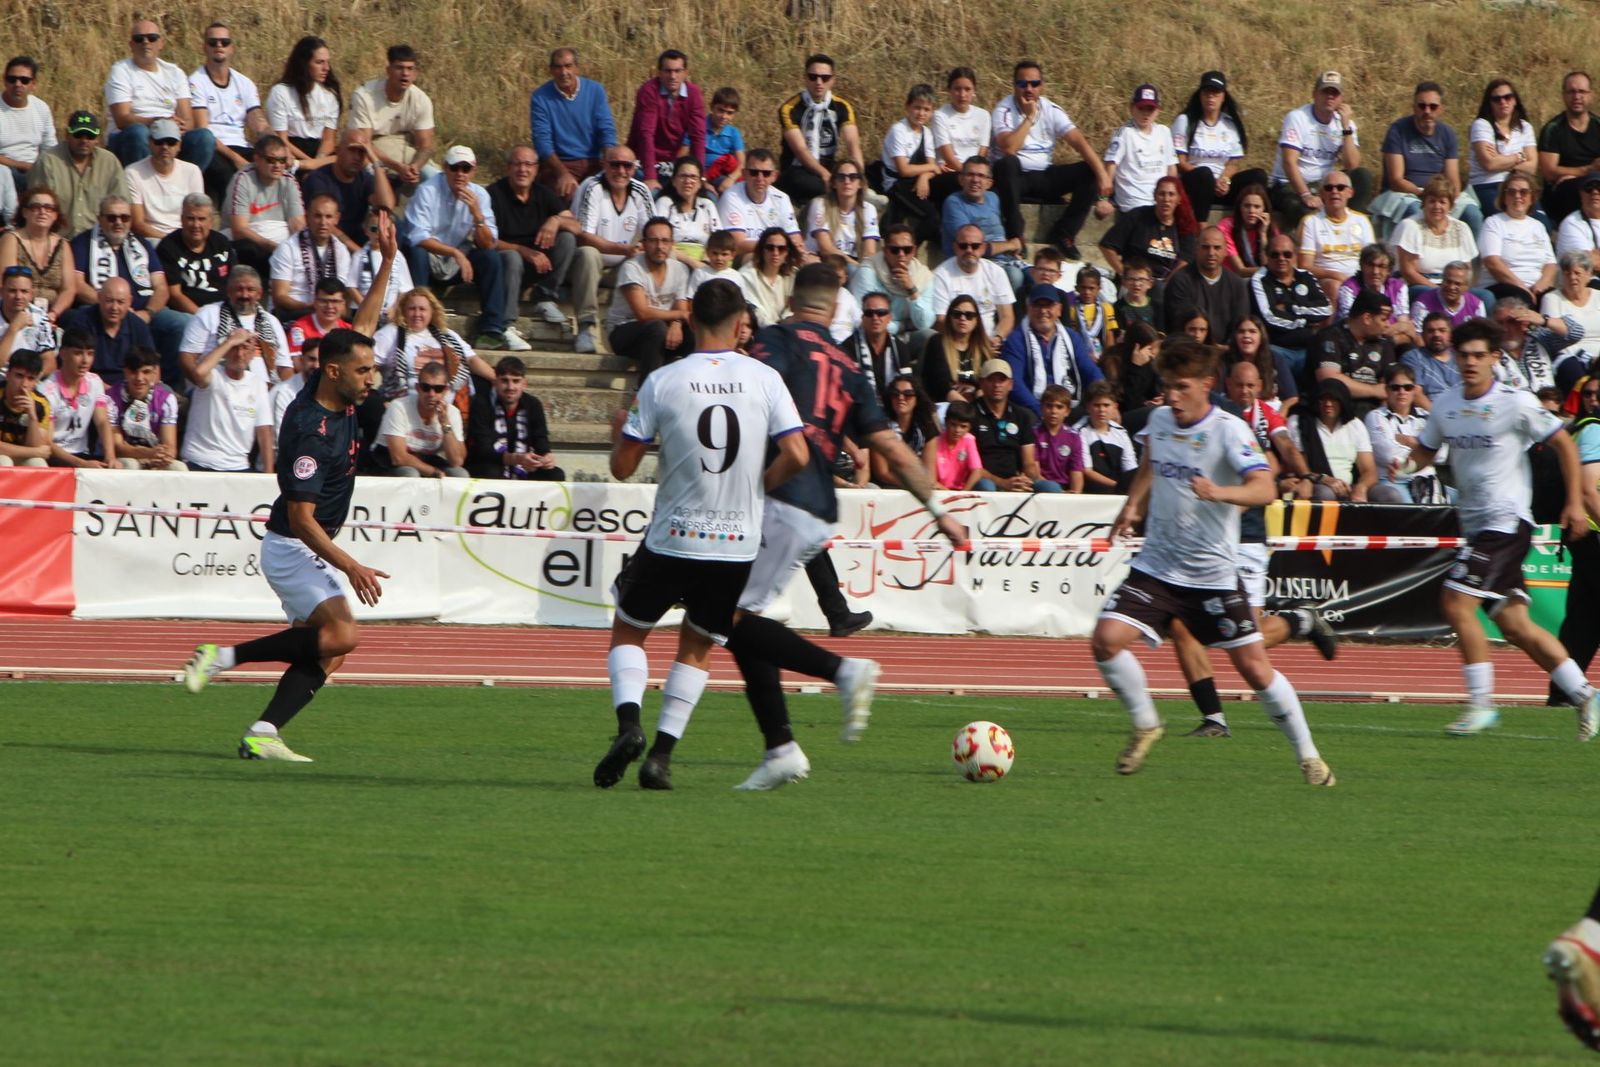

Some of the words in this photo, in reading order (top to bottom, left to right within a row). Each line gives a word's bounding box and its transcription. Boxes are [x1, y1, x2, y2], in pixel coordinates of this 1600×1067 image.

[688, 382, 746, 394] MAIKEL
[697, 404, 741, 474] 9
[172, 552, 237, 577] Coffee
[543, 539, 593, 587] el
[972, 576, 1106, 597] MESÓN
